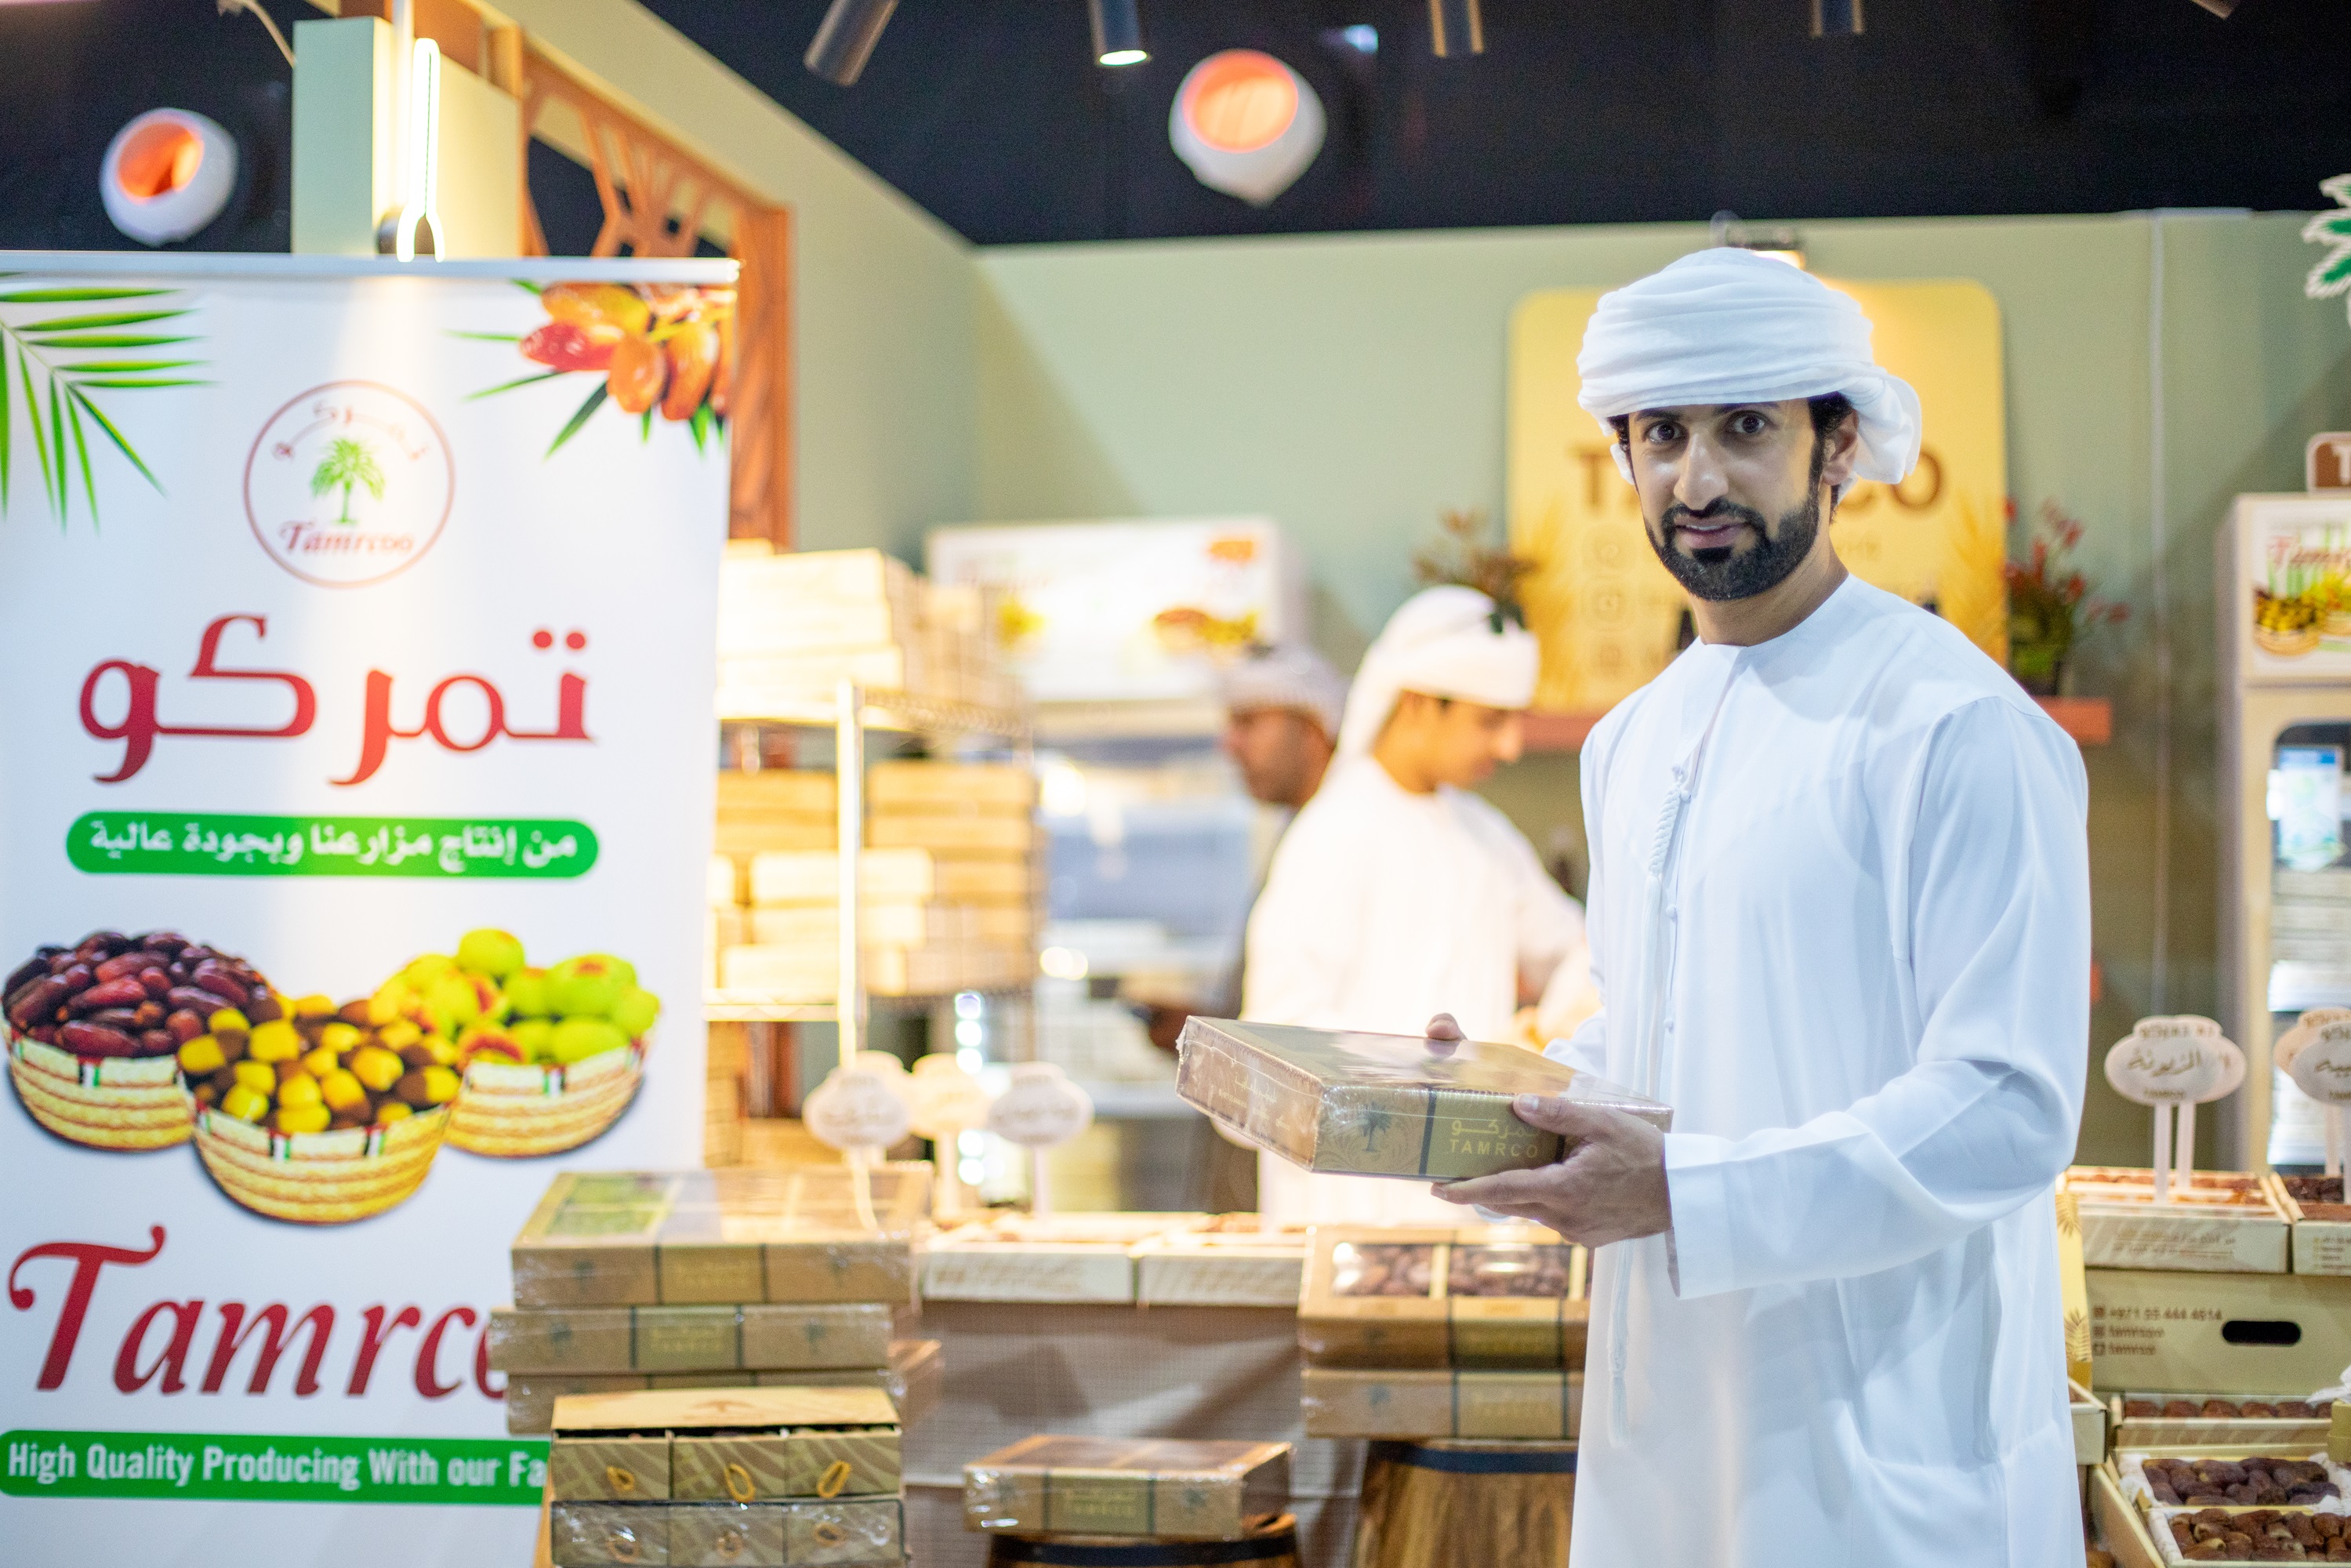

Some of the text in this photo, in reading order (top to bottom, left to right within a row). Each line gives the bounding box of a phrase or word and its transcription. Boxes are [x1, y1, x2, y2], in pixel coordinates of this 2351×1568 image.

[78, 614, 599, 787] تمركو
[89, 820, 174, 860] عالية
[182, 822, 305, 865] وبجودة
[310, 823, 434, 866] مزارعنا
[522, 829, 579, 869] من
[1450, 1138, 1539, 1159] TAMRCO
[9, 1442, 76, 1484] High
[87, 1443, 194, 1487] Quality
[202, 1446, 361, 1491] Producing
[368, 1448, 438, 1485] With
[448, 1457, 500, 1486] our
